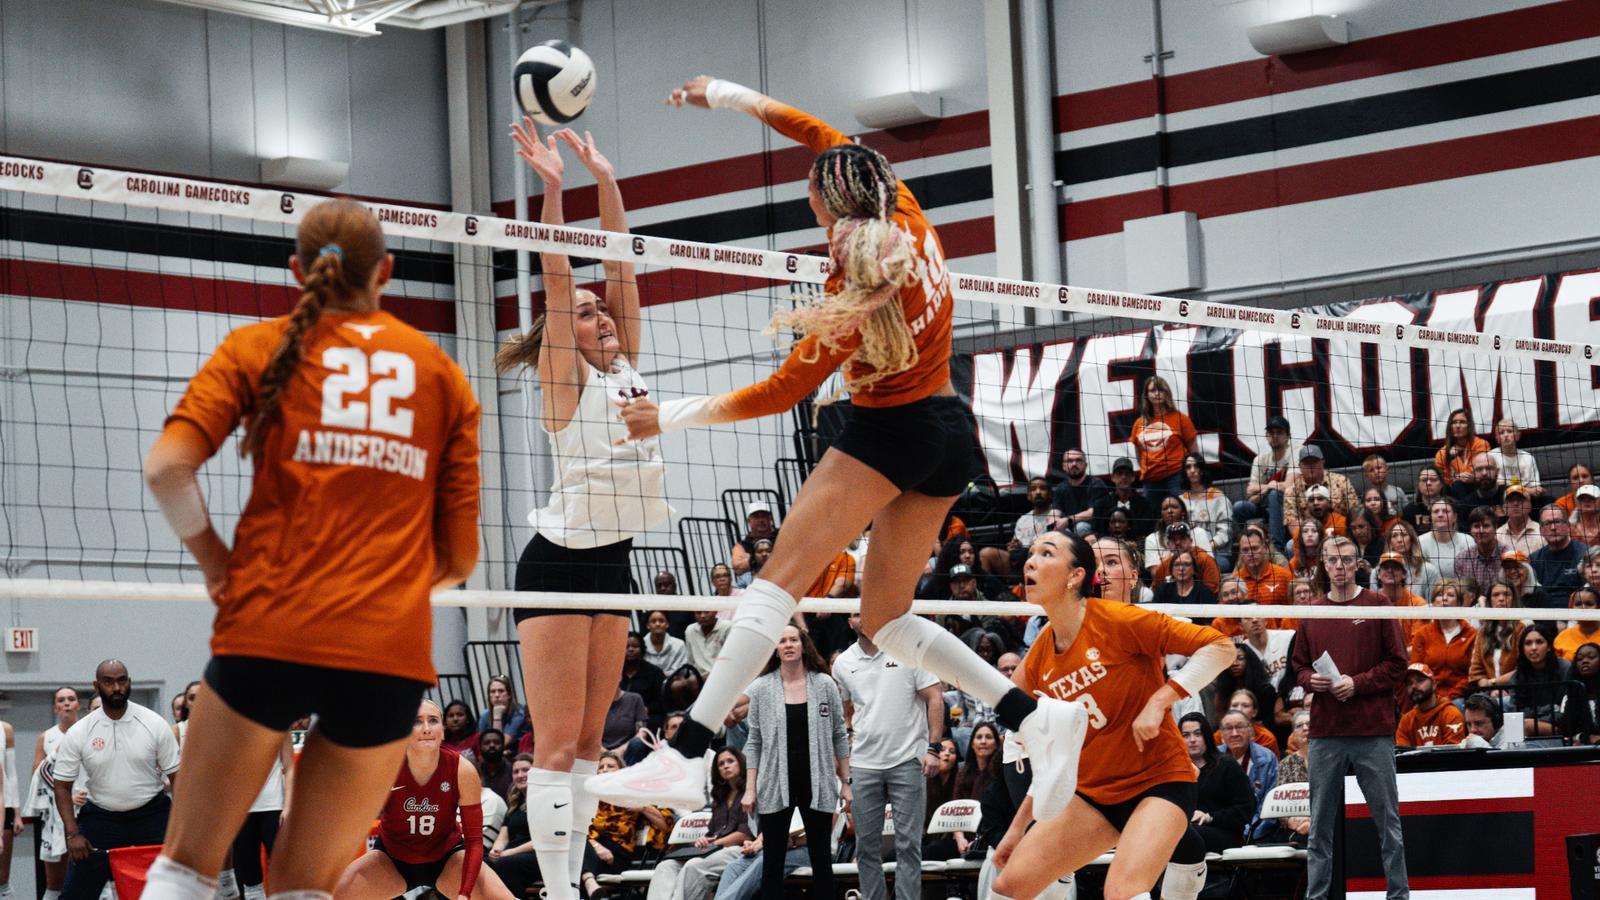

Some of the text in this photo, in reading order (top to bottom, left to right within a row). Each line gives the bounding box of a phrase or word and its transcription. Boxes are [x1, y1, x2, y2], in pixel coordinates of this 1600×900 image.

[126, 177, 250, 206] CAROLINA GAMECOCKS
[378, 208, 438, 229] GAMECOCKS
[505, 223, 608, 249] CAROLINA GAMECOCKS
[670, 243, 763, 267] CAROLINA GAMECOCKS
[959, 278, 1040, 299] CAROLINA GAMECOCKS
[1087, 292, 1162, 312] CAROLINA GAMECOCKS
[1206, 305, 1275, 325] CAROLINA GAMECOCKS
[1316, 318, 1381, 336] CAROLINA GAMECOCKS
[1418, 329, 1480, 346] CAROLINA GAMECOCKS
[1515, 339, 1572, 355] CAROLINA GAMECOCKS
[321, 346, 416, 439] 22
[292, 428, 429, 481] ANDERSON
[13, 629, 33, 649] EXIT
[1047, 660, 1108, 700] TEXAS
[404, 797, 439, 812] Carolina
[406, 815, 435, 836] 18
